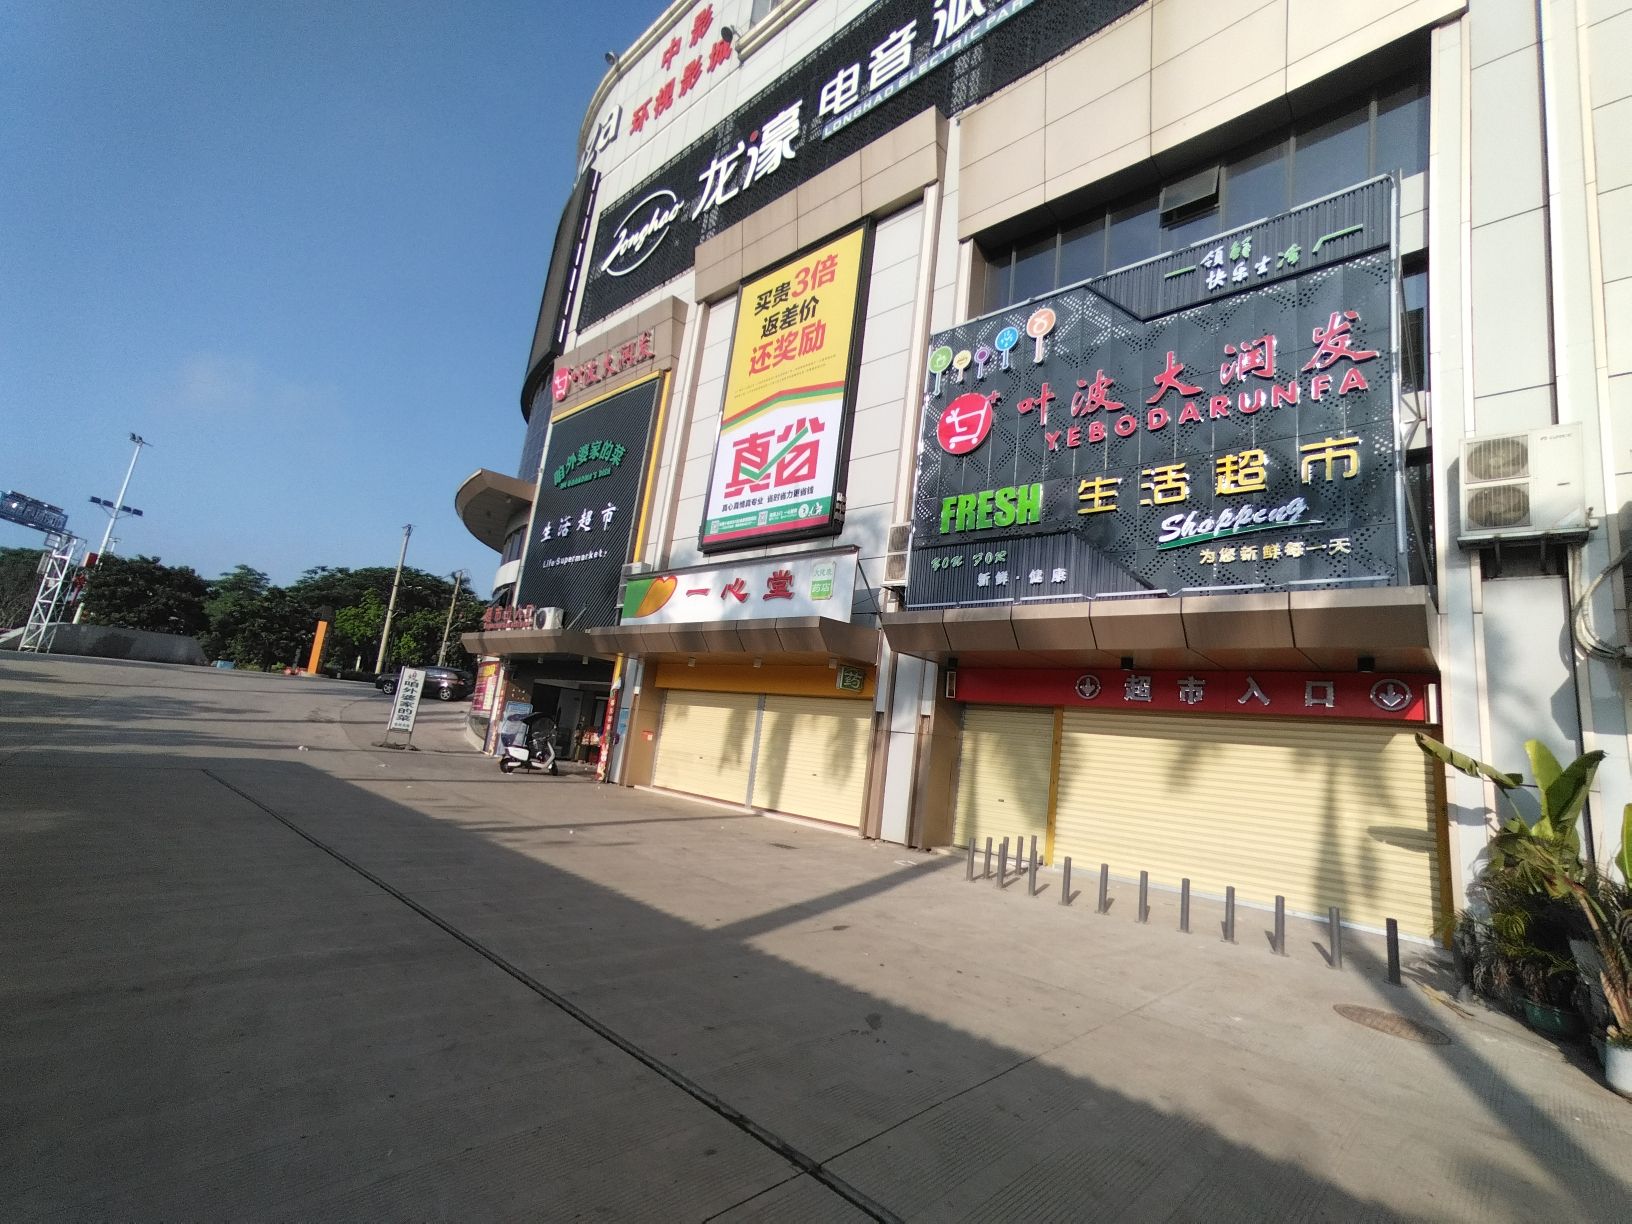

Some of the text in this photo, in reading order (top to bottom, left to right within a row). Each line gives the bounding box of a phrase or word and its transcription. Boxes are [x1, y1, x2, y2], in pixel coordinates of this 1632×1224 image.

[824, 86, 894, 135] LONGHAO
[898, 26, 980, 88] ELECTRIC
[754, 254, 839, 316] 买贵3倍
[761, 295, 820, 339] 返差价
[748, 319, 827, 376] 还奖励
[1016, 311, 1380, 425] 叶波大润发
[1046, 367, 1369, 450] YEBODARUNFA
[1077, 436, 1361, 515] 生活超市
[540, 502, 617, 543] 生活超市
[939, 483, 1044, 534] FRESH
[1200, 537, 1351, 565] 为您新鲜每一天
[686, 569, 796, 604] 一心堂
[812, 582, 831, 594] 药店
[844, 669, 863, 689] 药
[1124, 674, 1335, 708] 超市入口
